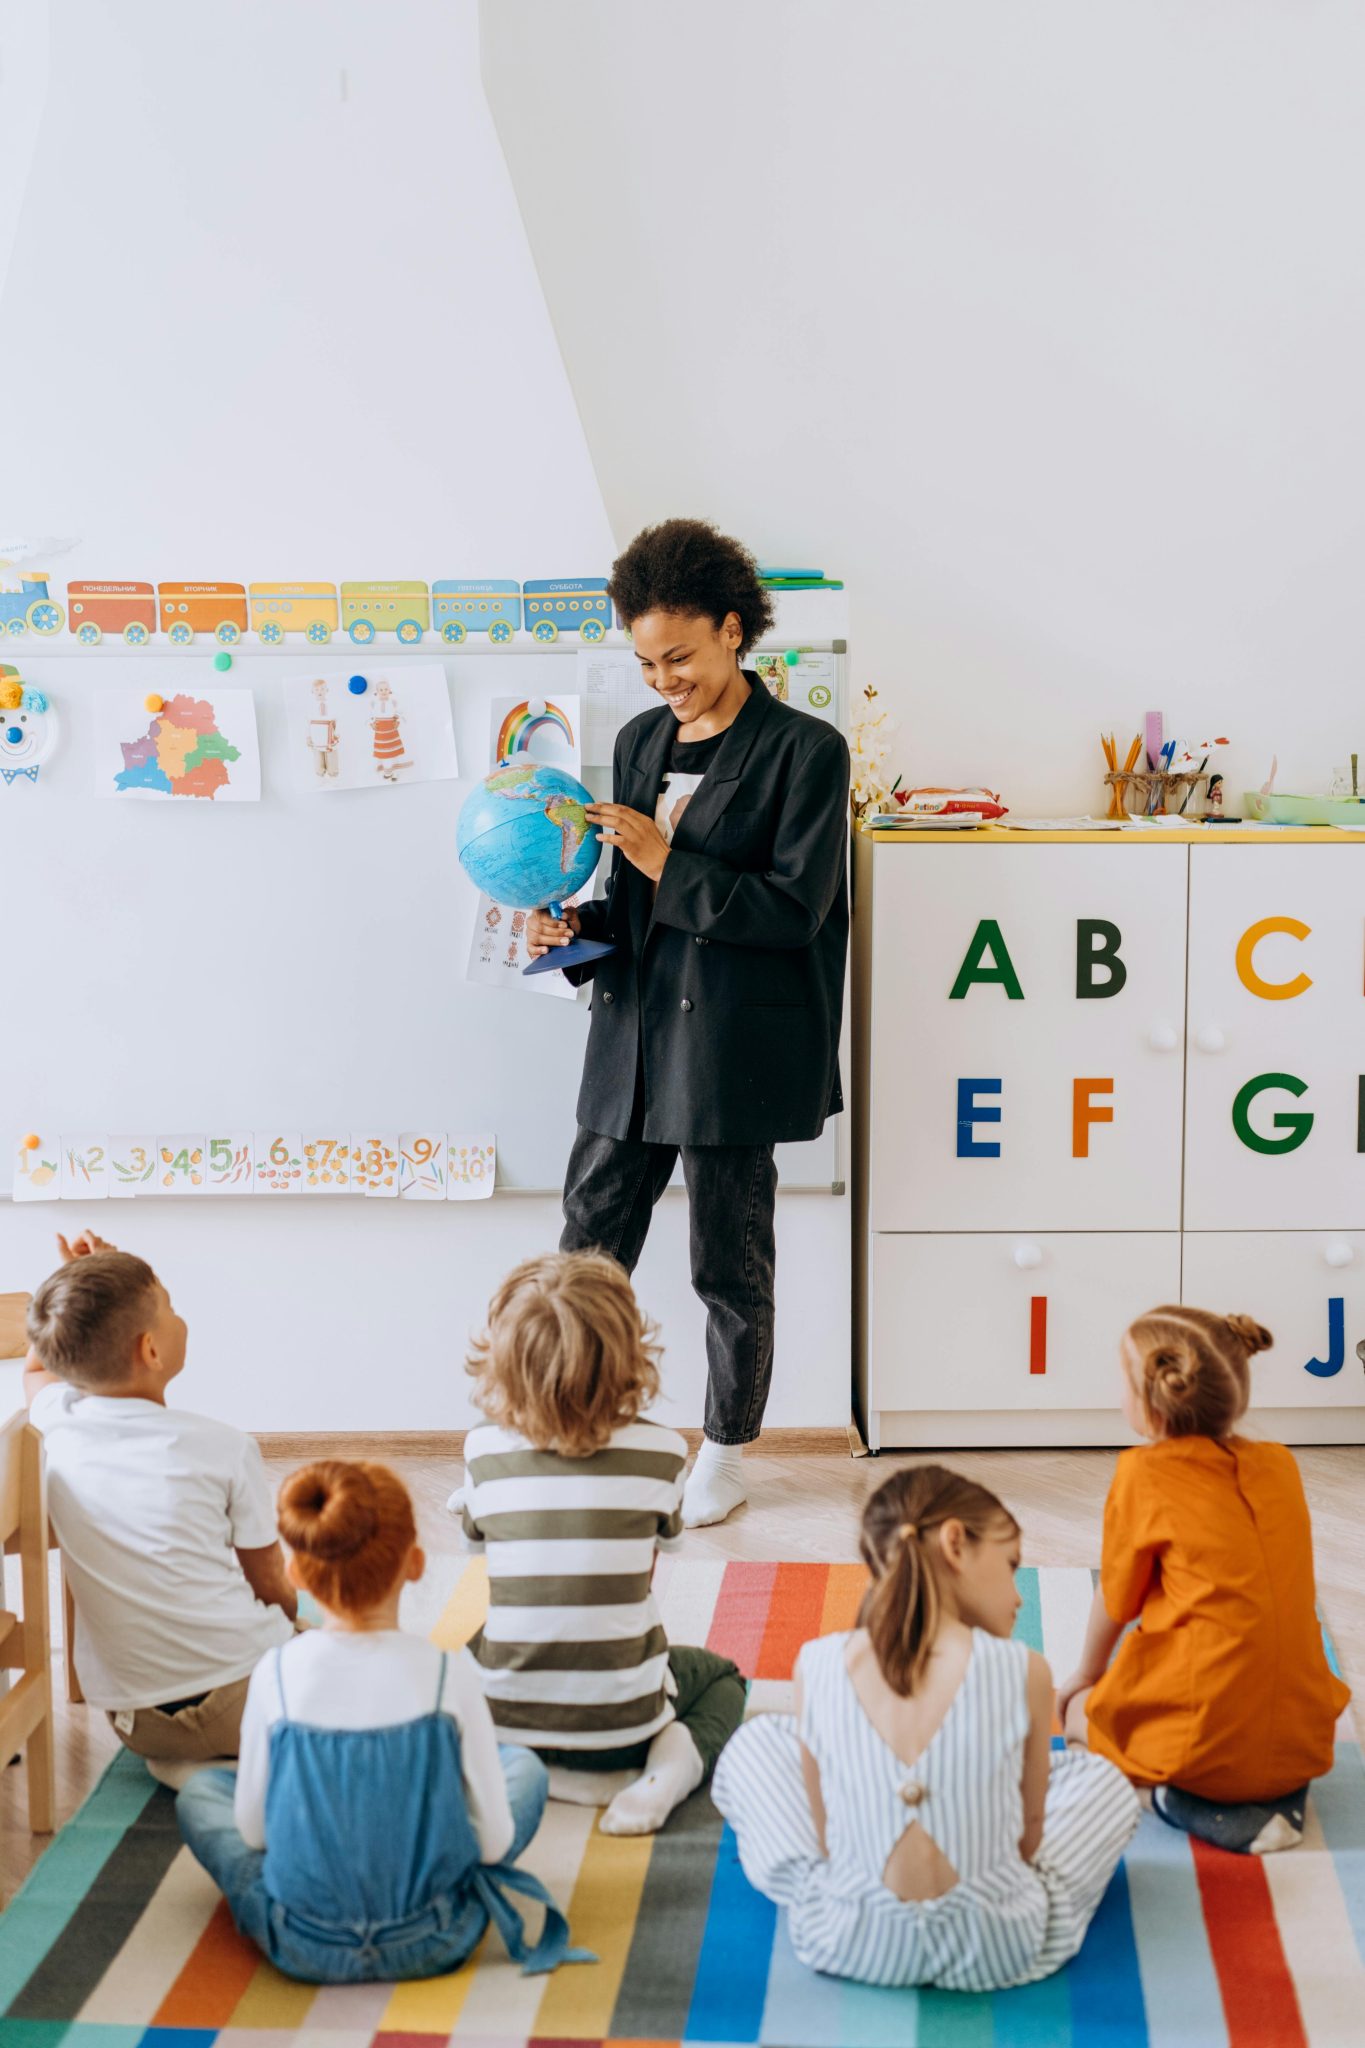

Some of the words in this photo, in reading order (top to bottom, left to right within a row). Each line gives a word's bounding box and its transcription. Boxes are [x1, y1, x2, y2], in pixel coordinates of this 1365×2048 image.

[82, 584, 137, 592] ПОНЕДЕЛЬНИК
[549, 583, 583, 591] СУББОТА
[948, 920, 1026, 1000] A
[1076, 919, 1128, 1000] B
[1236, 917, 1312, 1000] C
[957, 1078, 1003, 1157] E
[1072, 1078, 1114, 1157] F
[1232, 1073, 1315, 1155] G
[18, 1148, 29, 1173] 1
[87, 1146, 104, 1172] 2
[130, 1147, 146, 1172] 3
[171, 1148, 192, 1176] 4
[210, 1139, 233, 1172] 5
[270, 1137, 289, 1165] 6
[316, 1140, 338, 1167] 7
[366, 1150, 383, 1176] 8
[414, 1138, 432, 1165] 9
[461, 1159, 484, 1179] 10
[1030, 1296, 1047, 1374] I
[1304, 1298, 1346, 1377] J
